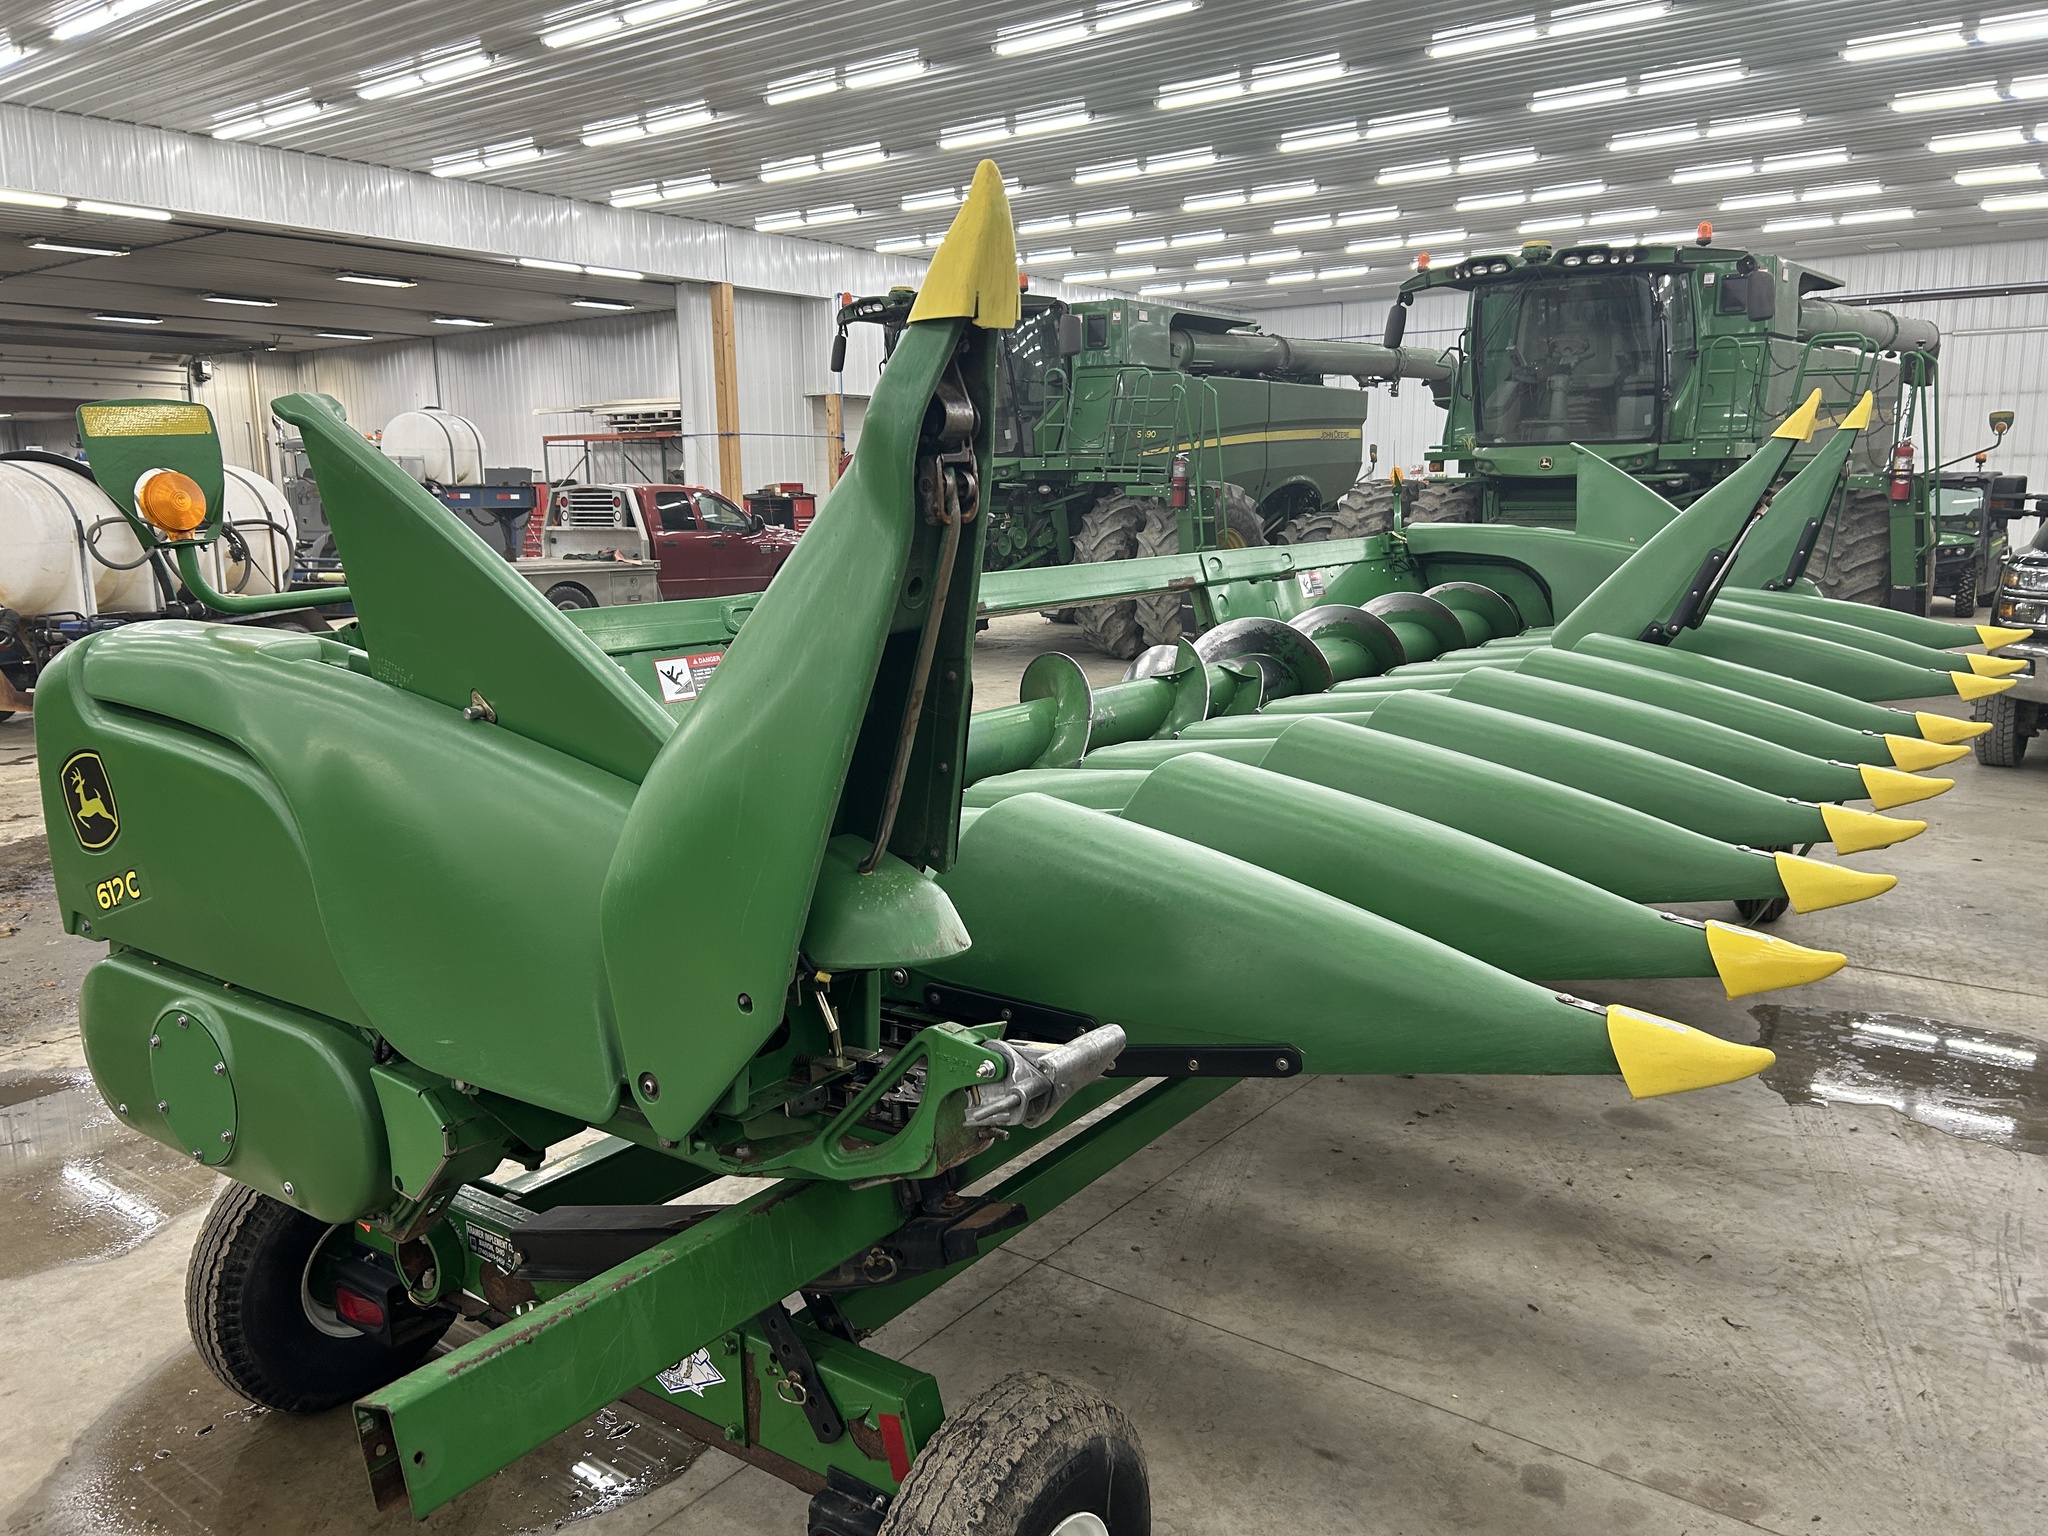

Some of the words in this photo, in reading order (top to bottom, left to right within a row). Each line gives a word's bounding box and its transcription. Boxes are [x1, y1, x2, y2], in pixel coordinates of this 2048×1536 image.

[1136, 430, 1157, 439] S90
[1320, 430, 1333, 439] JOHN
[1334, 430, 1350, 439] DEERE
[698, 655, 721, 664] DANGER
